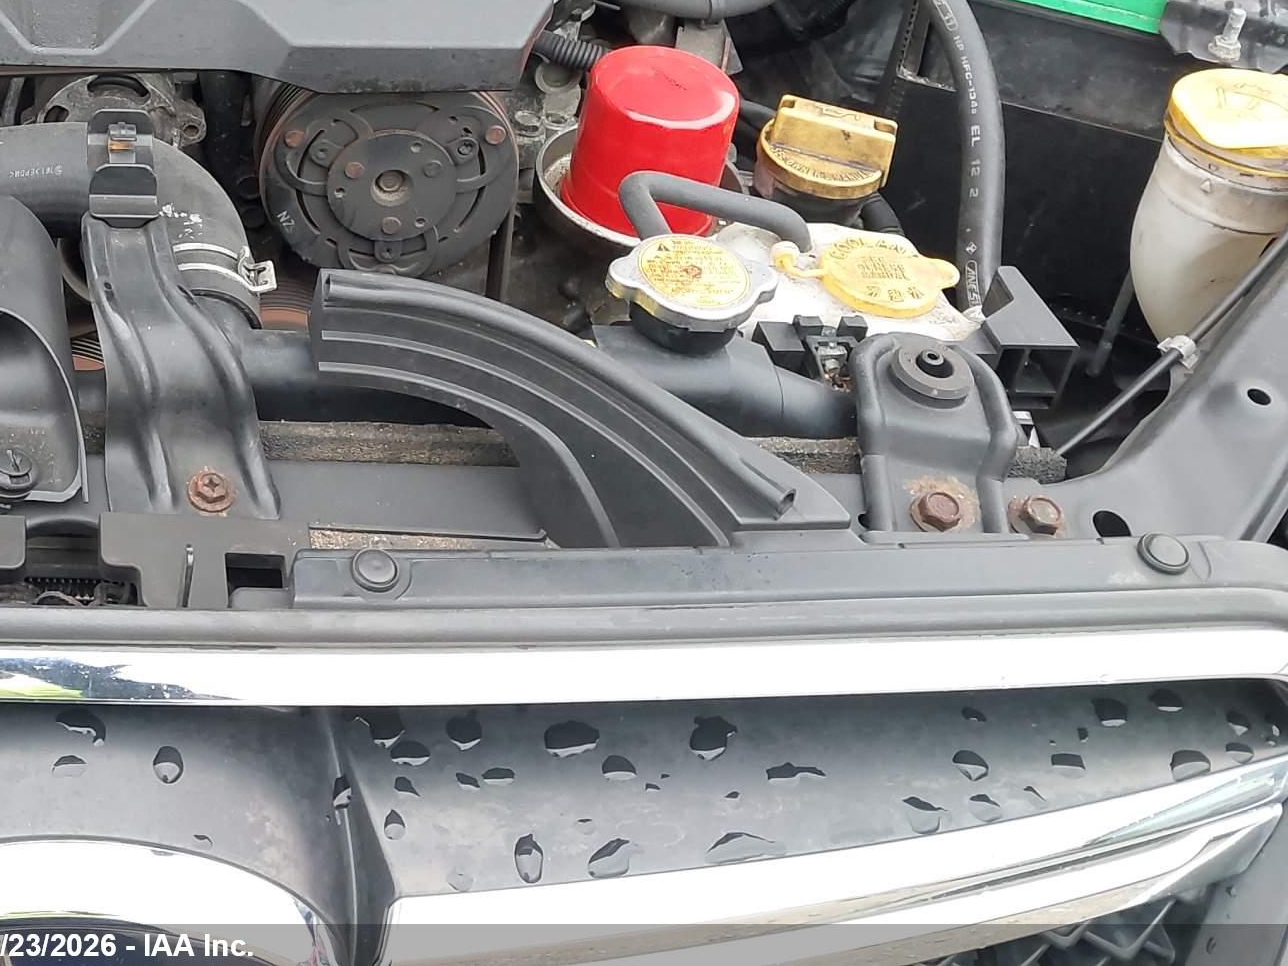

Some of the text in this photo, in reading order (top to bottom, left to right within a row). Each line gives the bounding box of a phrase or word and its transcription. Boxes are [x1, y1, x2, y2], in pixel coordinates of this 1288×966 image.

[970, 125, 981, 147] EL
[970, 158, 982, 176] 12
[969, 187, 979, 198] 2
